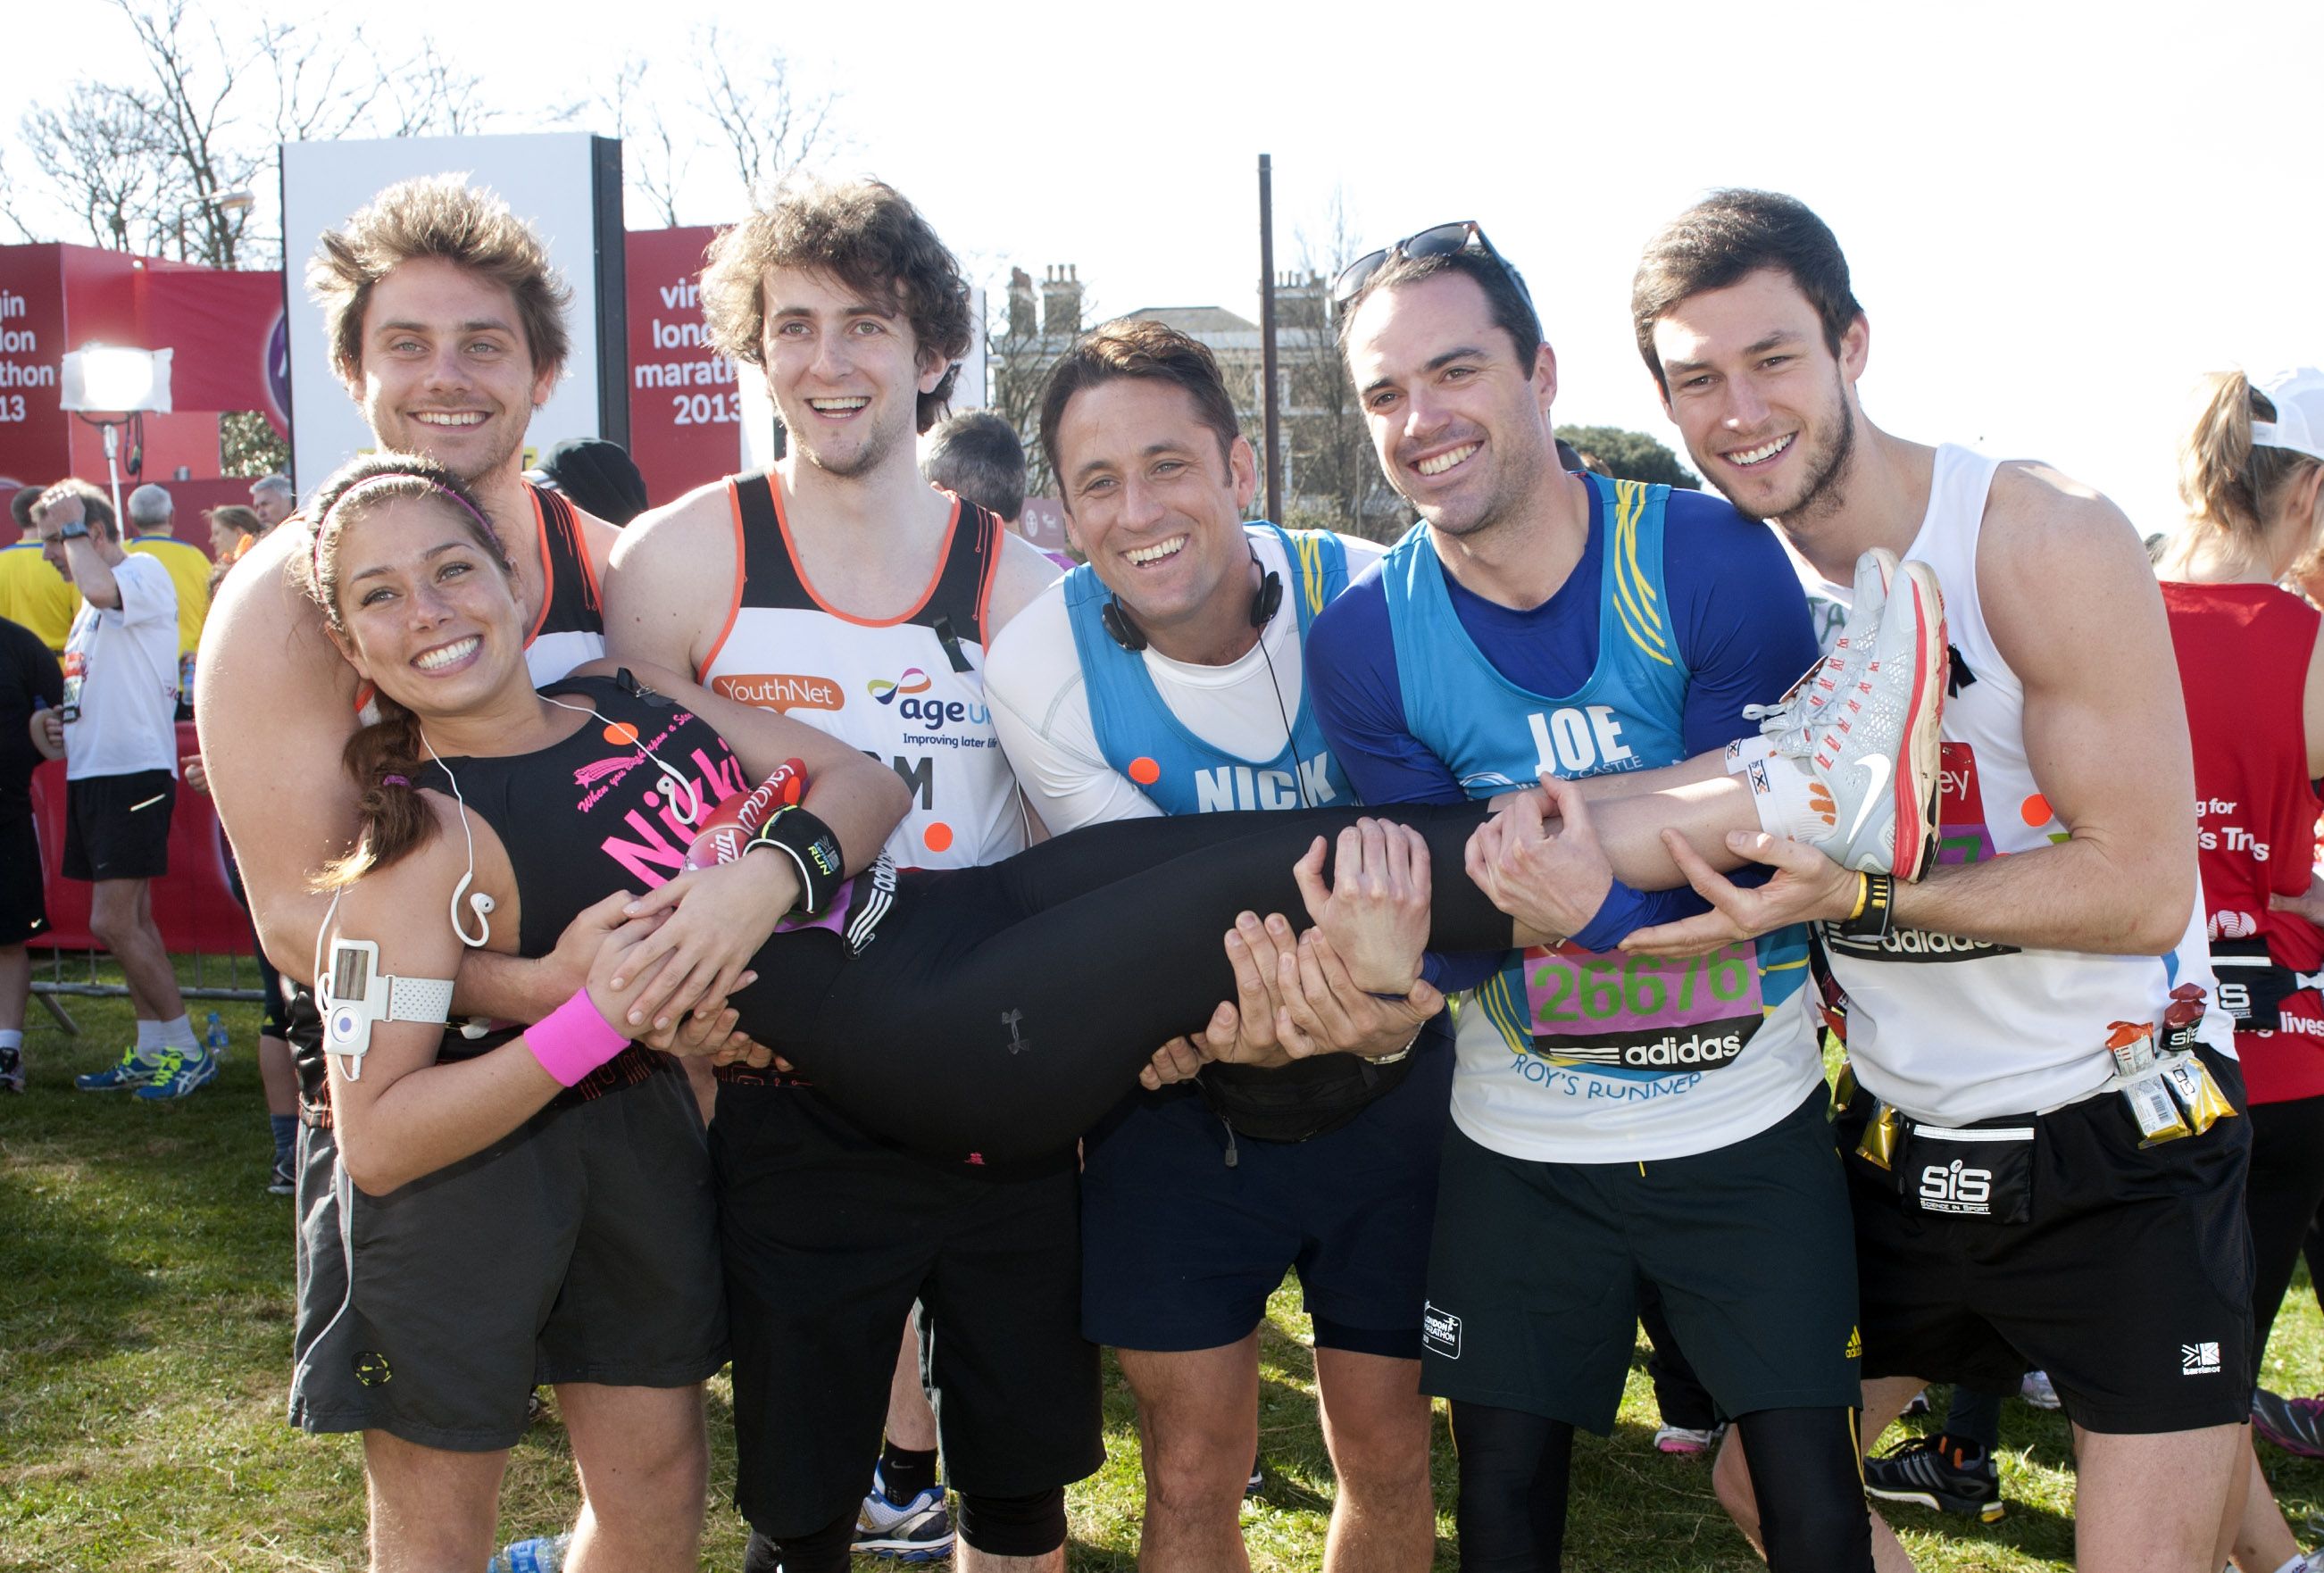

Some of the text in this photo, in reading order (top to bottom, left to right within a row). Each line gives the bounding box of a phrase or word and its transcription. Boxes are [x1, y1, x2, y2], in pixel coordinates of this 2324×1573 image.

[0, 288, 26, 322] in
[0, 326, 37, 353] on
[721, 678, 834, 705] YouthNet
[903, 732, 959, 749] Improving
[962, 735, 986, 748] later
[1528, 705, 1633, 778] JOE
[1195, 751, 1337, 813] NICK
[1578, 755, 1645, 779] CASTLE
[577, 785, 609, 812] When
[2209, 797, 2237, 814] for
[807, 845, 831, 876] RUN
[1533, 943, 1750, 1023] 26676
[1625, 1034, 1741, 1065] adidas
[1511, 1053, 1702, 1101] ROY'S RUNNER
